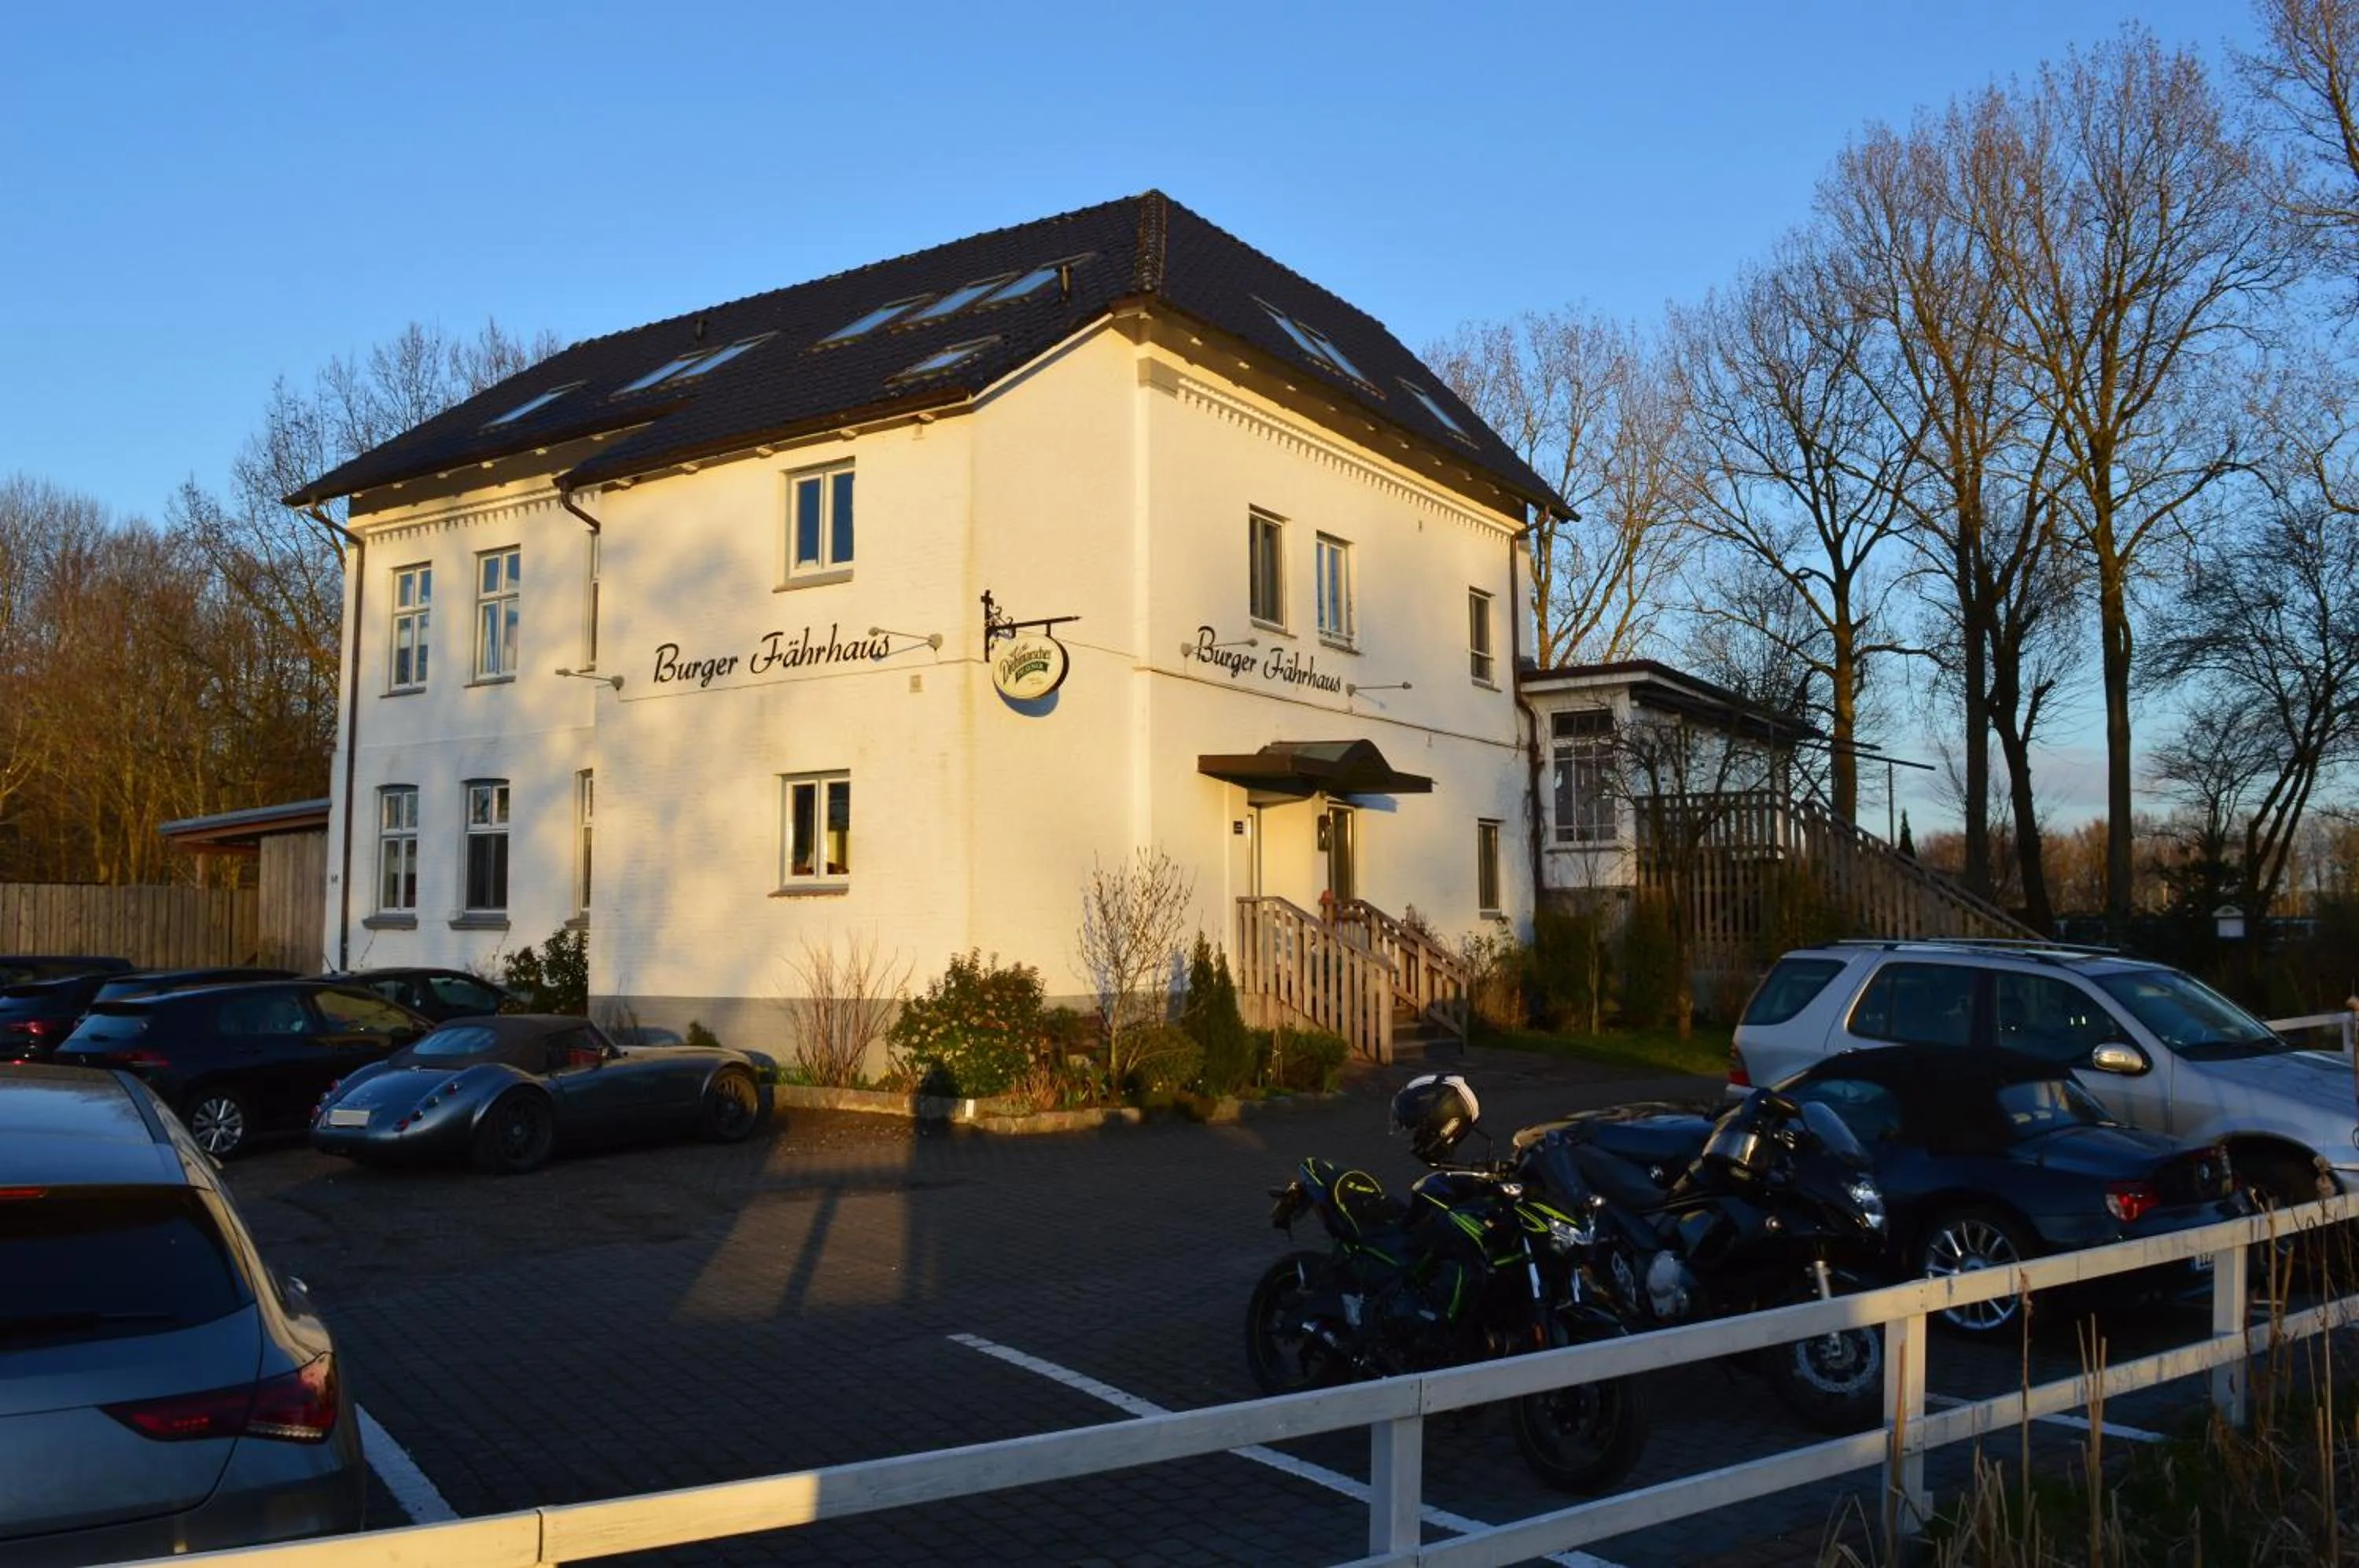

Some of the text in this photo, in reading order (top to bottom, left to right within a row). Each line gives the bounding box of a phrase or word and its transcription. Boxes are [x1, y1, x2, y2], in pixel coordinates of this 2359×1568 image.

[654, 623, 889, 687] Burger Fährhaus
[1196, 625, 1341, 693] Burger Fährhaus
